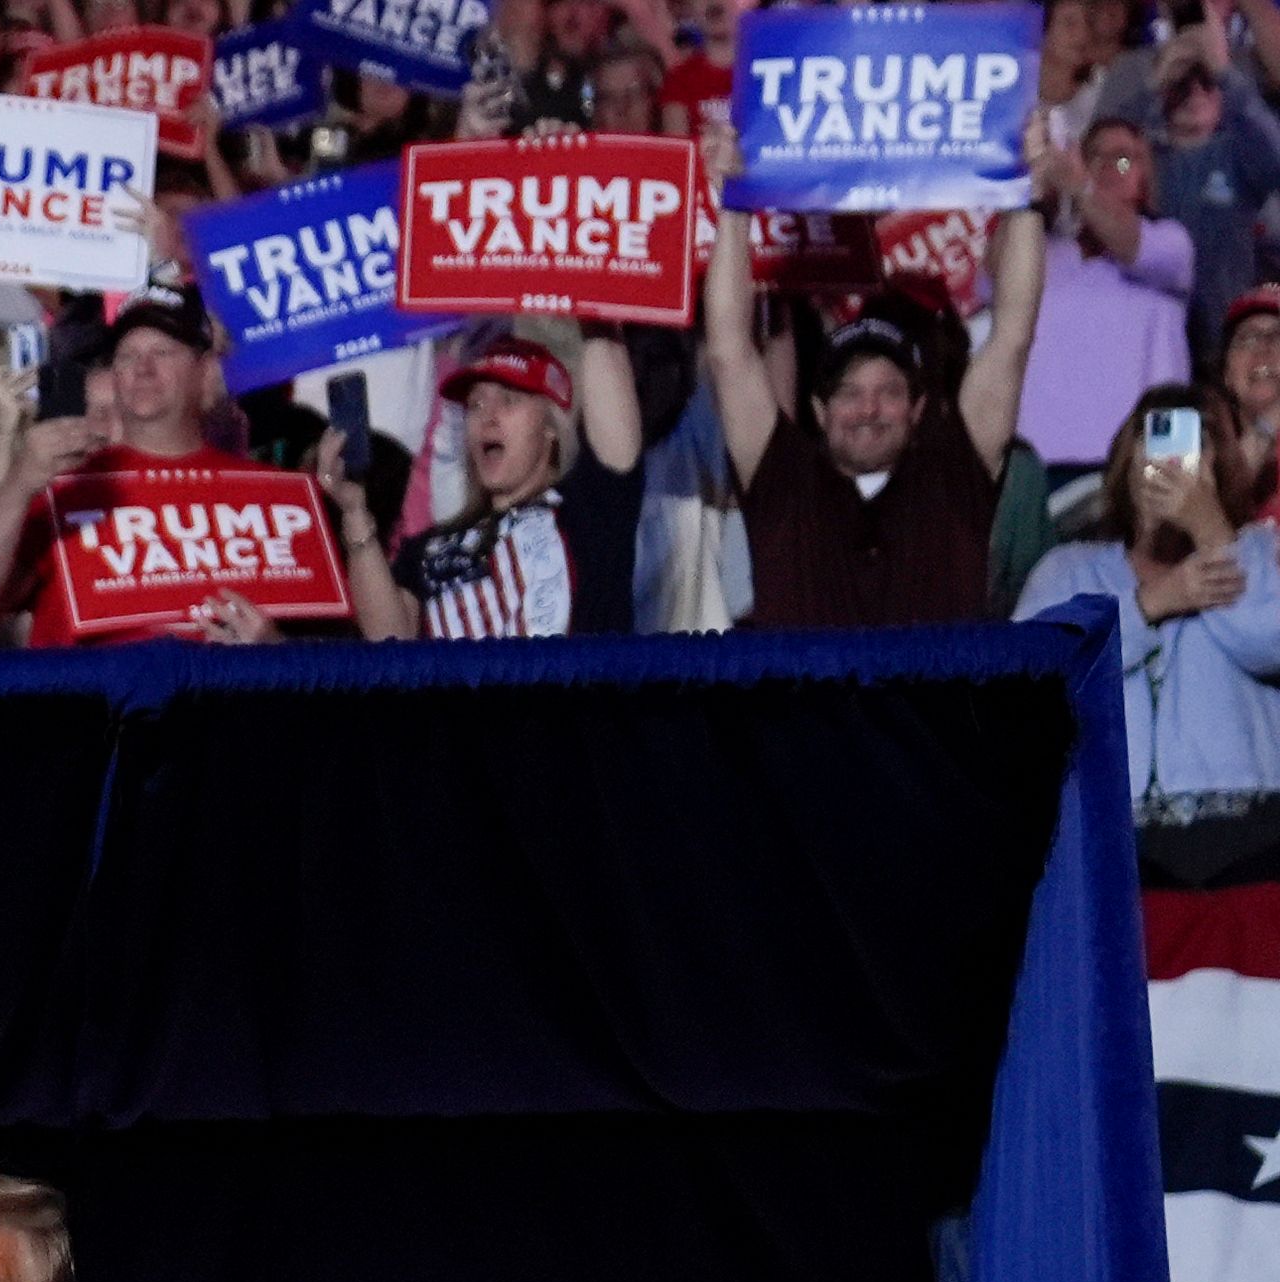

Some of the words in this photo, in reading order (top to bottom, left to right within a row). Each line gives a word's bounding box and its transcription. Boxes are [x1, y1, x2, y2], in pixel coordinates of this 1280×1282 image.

[750, 53, 1020, 108] TRUMP
[777, 101, 986, 143] VANCE
[419, 175, 682, 224] TRUMP
[209, 206, 401, 293] TRUM
[448, 216, 652, 259] VANCE
[246, 250, 397, 320] VANC
[64, 503, 313, 549] TRUMP
[100, 535, 298, 576] VANCE
